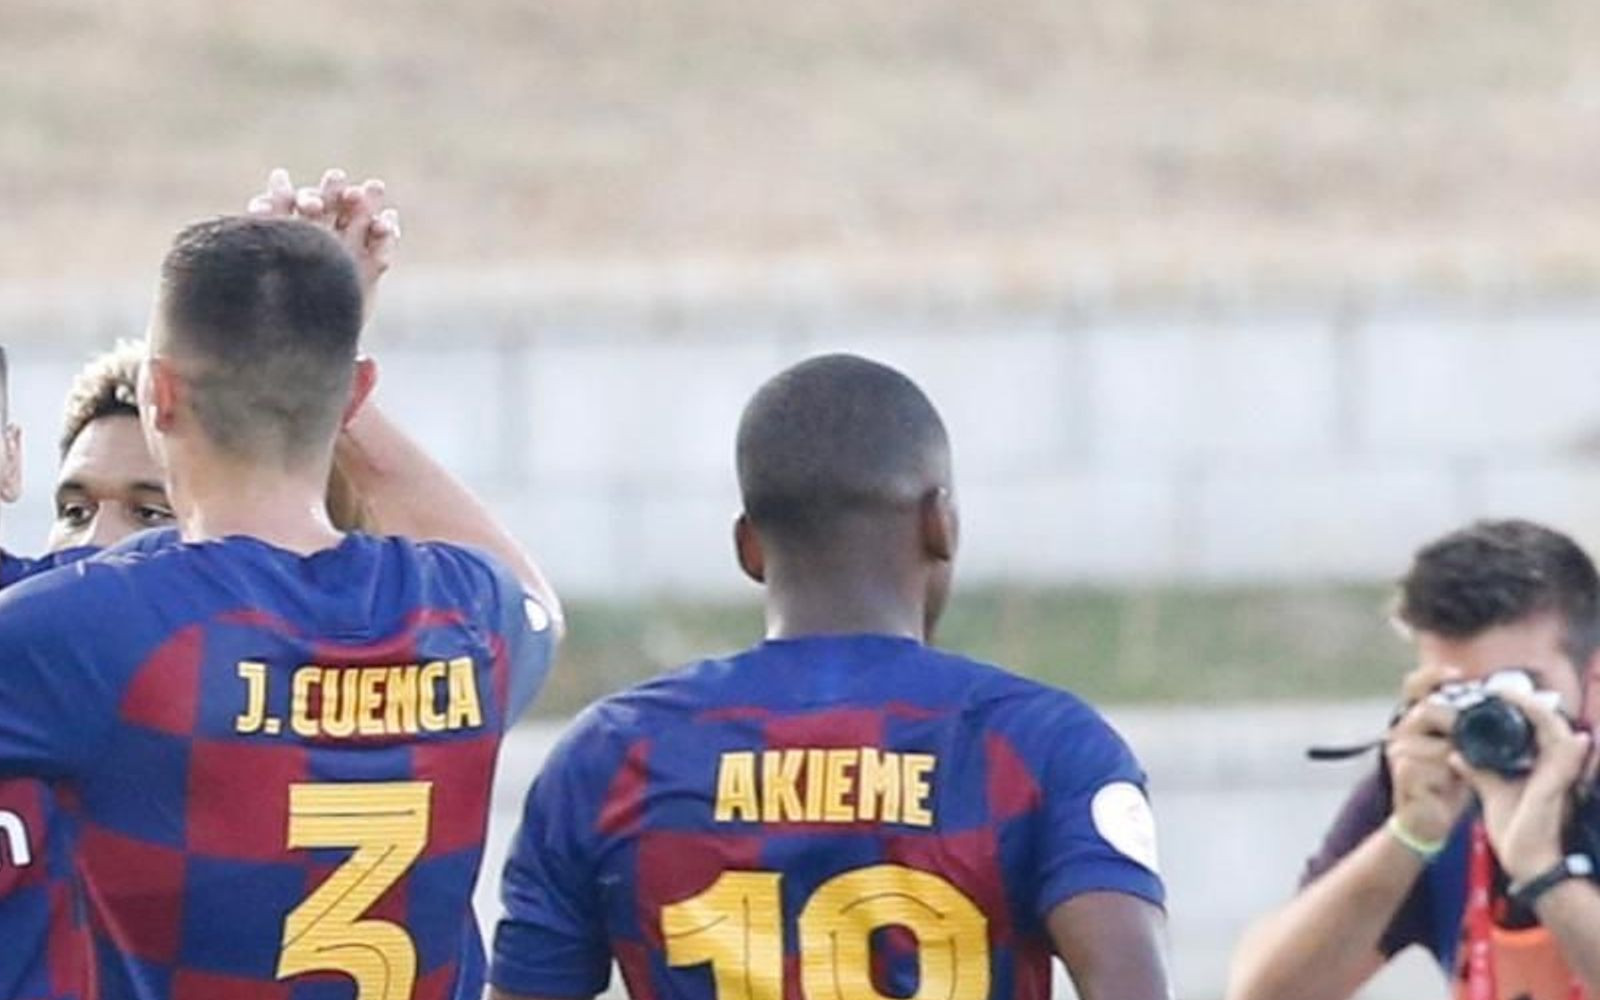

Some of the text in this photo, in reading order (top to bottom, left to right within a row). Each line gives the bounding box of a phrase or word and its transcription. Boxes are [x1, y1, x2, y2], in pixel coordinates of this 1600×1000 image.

[236, 656, 483, 737] J. CUENCA
[714, 747, 936, 826] AKIEME
